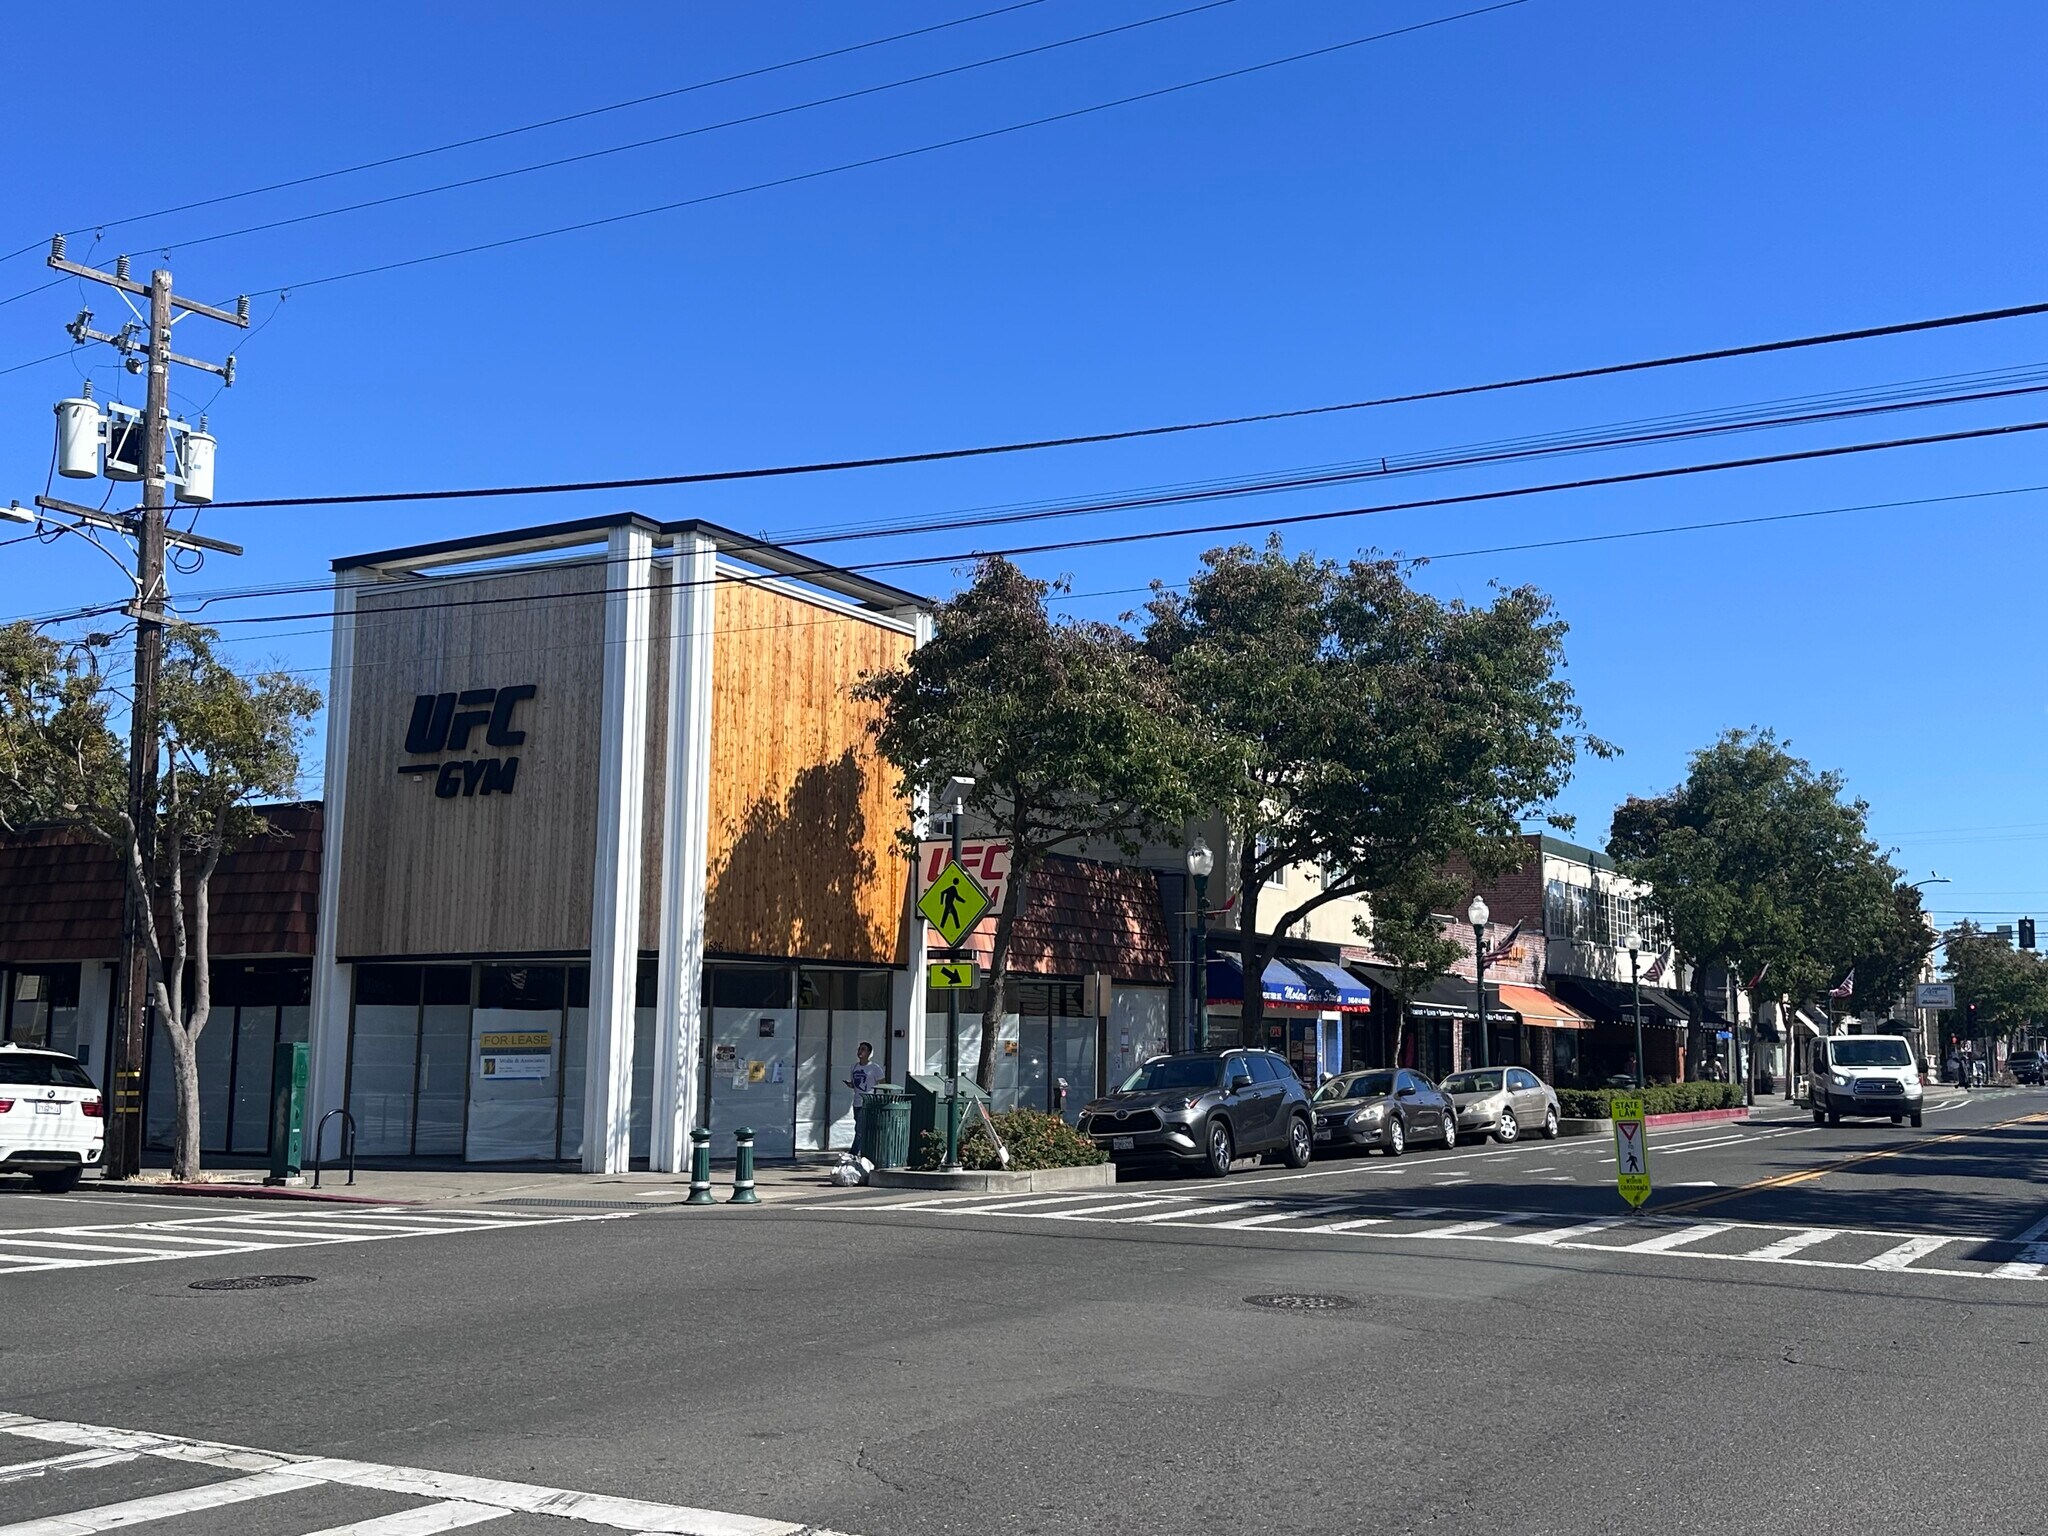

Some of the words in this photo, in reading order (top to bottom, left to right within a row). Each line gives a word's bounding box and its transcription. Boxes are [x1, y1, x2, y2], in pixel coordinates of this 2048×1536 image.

[405, 685, 537, 753] UFC
[435, 757, 519, 799] GYM
[484, 1036, 508, 1045] FOR
[511, 1035, 548, 1045] LEASE
[1615, 1101, 1640, 1110] STATE
[1619, 1109, 1637, 1118] LAW
